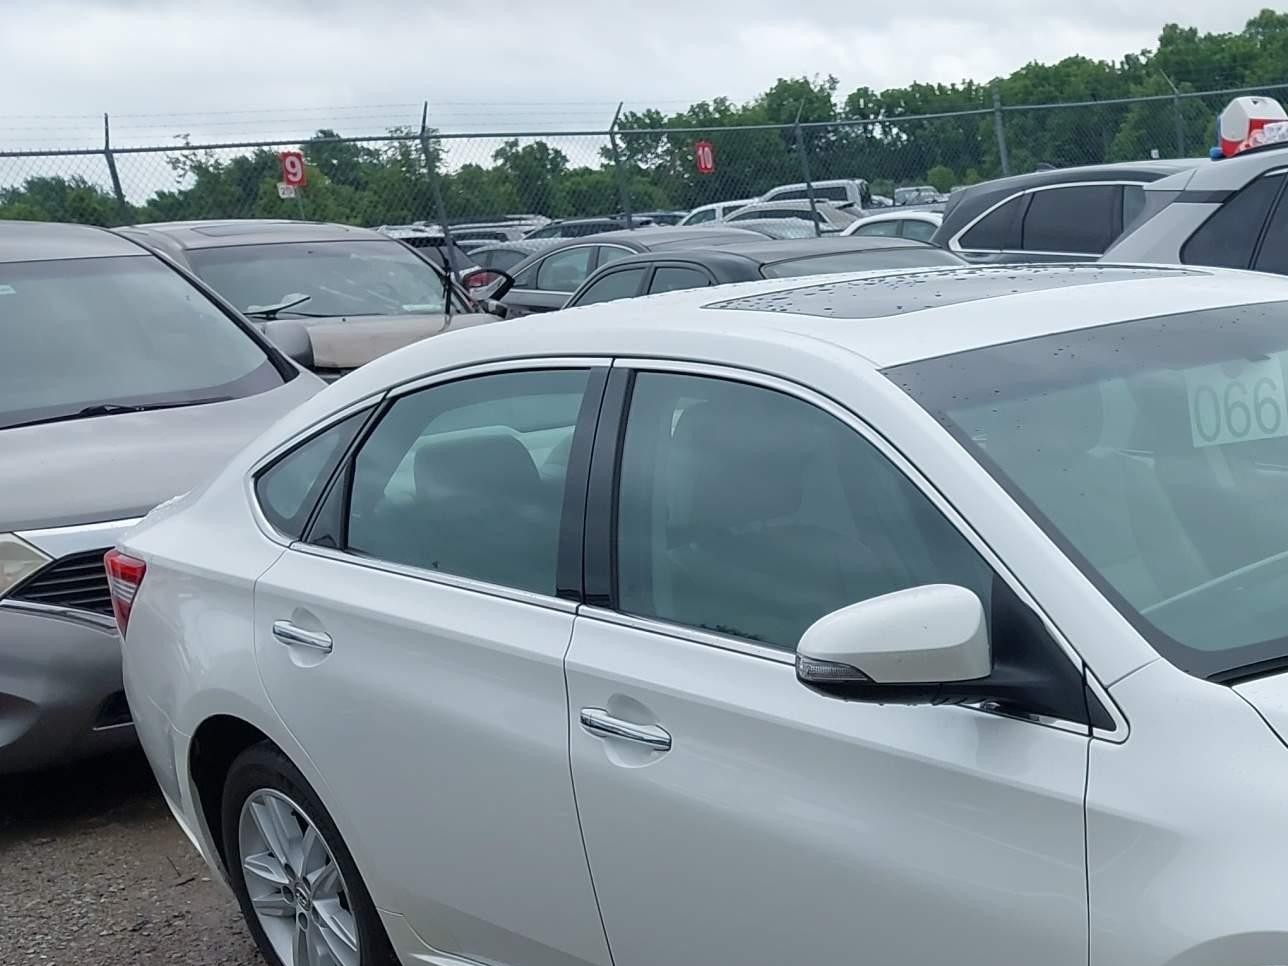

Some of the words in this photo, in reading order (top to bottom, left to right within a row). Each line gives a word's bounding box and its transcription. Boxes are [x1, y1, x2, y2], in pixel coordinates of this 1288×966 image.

[285, 155, 302, 182] 9
[698, 146, 712, 169] 10
[1194, 377, 1281, 442] 066
